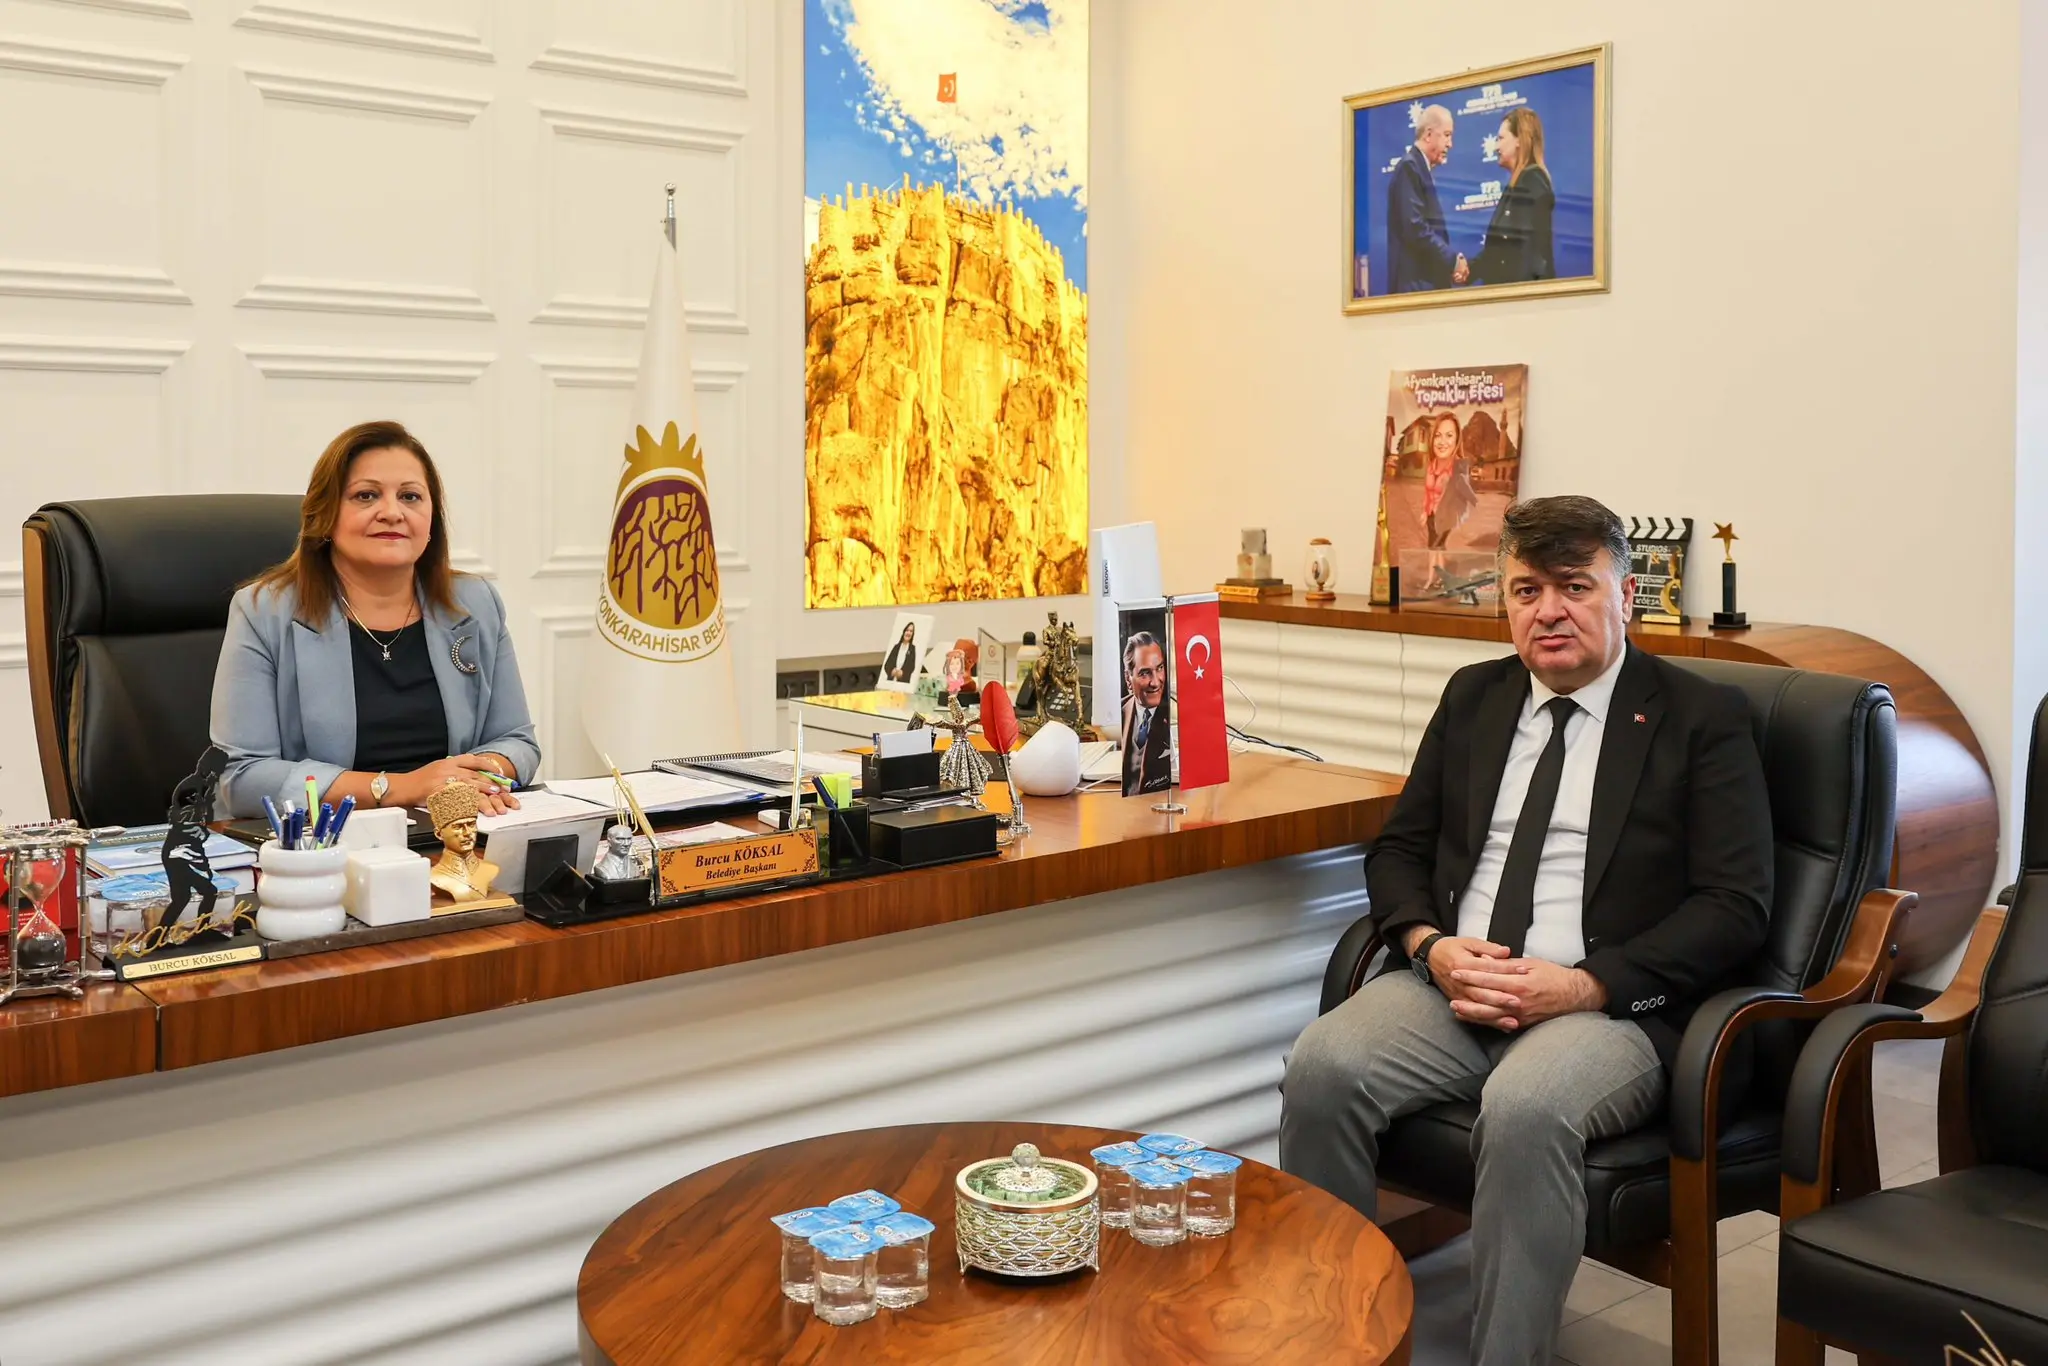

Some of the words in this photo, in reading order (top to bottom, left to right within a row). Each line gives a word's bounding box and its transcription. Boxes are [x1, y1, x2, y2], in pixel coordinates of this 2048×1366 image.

[1415, 383, 1466, 408] Topuklu
[1469, 382, 1504, 401] Efesi
[695, 854, 730, 868] Burcu
[733, 843, 785, 862] KÖKSAL
[706, 867, 742, 880] Belediye
[743, 862, 777, 875] Başkanı
[148, 959, 189, 973] BURCU
[192, 952, 237, 967] KÖKSAL
